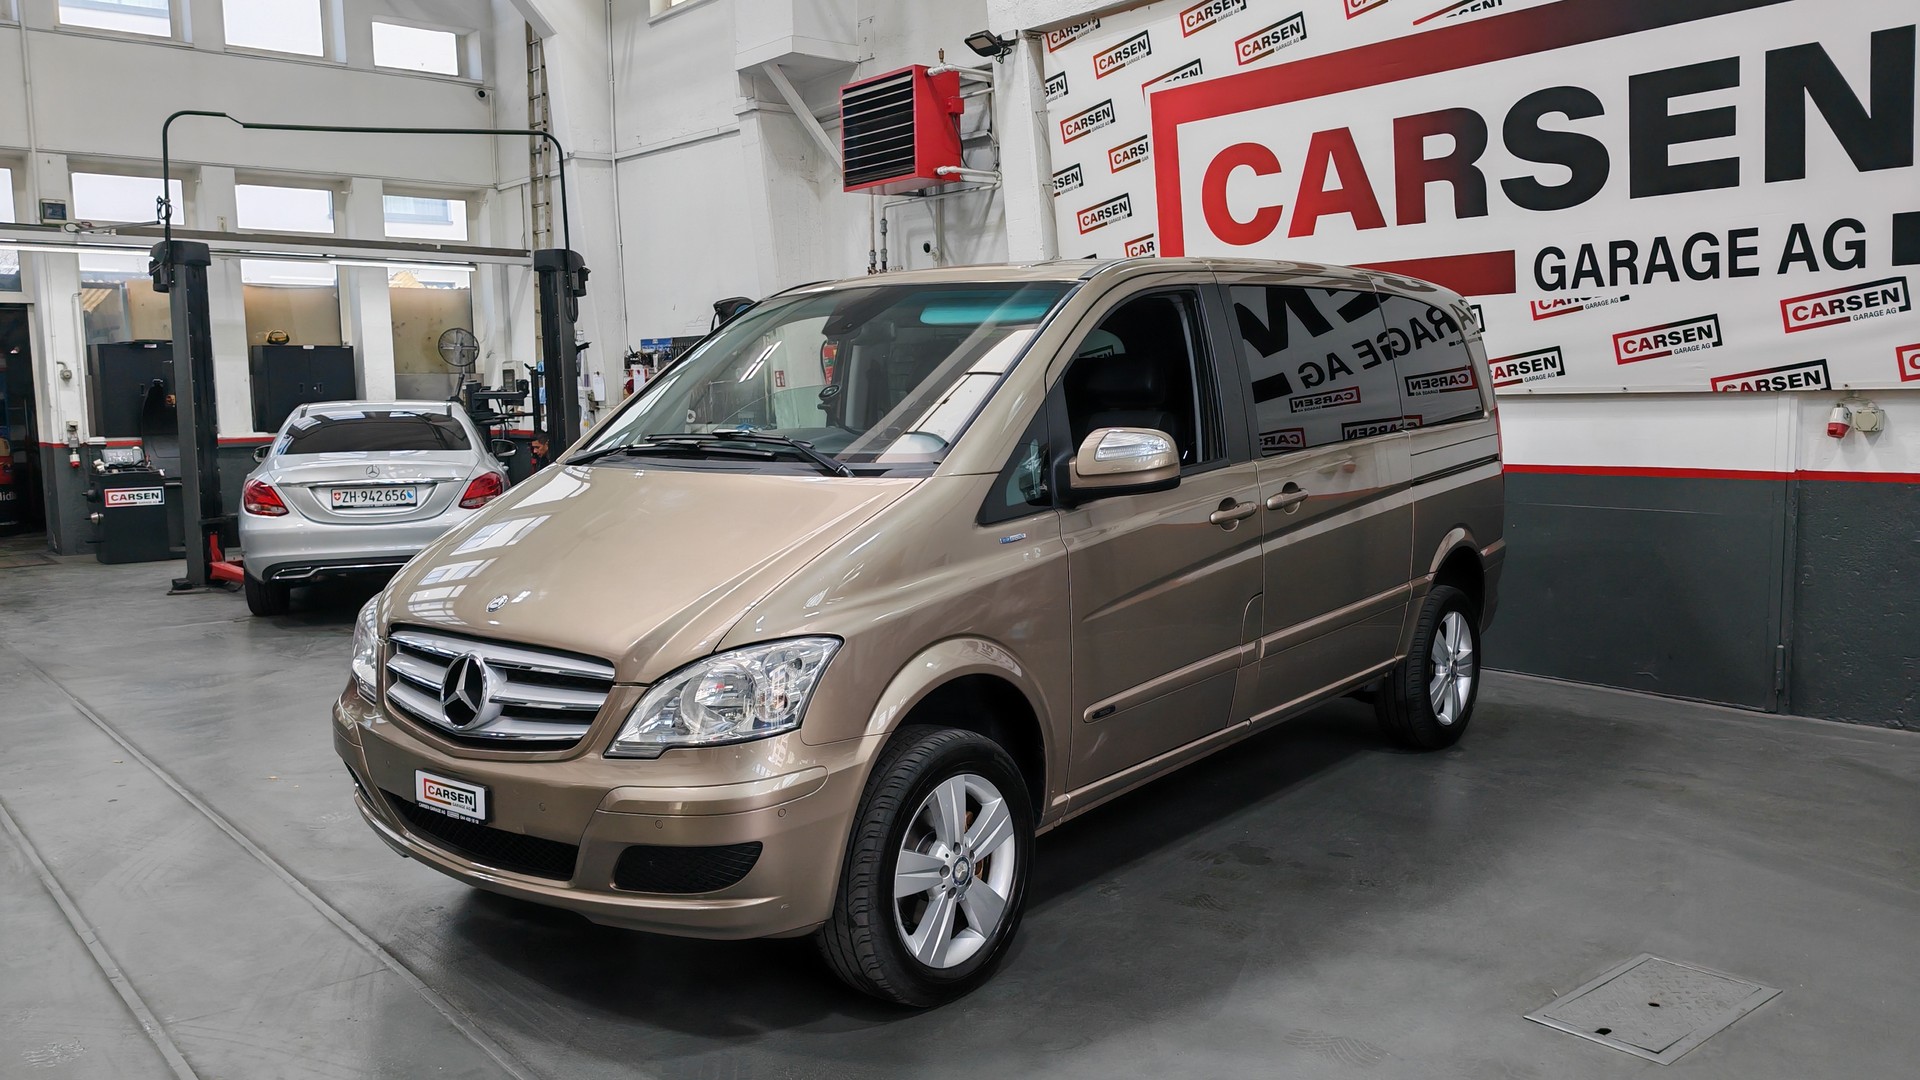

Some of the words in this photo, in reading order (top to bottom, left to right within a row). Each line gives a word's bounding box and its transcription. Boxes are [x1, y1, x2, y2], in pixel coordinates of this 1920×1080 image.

[1241, 21, 1301, 57] CARSEN
[1099, 39, 1147, 70] CARSEN
[1065, 107, 1110, 135] CARSEN
[1201, 24, 1916, 246] CARSEN
[1082, 200, 1128, 226] CARSEN
[1533, 227, 1760, 291] GARAGE
[1777, 218, 1867, 275] AG
[1584, 299, 1609, 310] GARAGE
[1610, 297, 1618, 305] AG
[1792, 287, 1900, 322] CARSEN
[1852, 310, 1884, 321] GARAGE
[1885, 307, 1897, 316] AG
[1622, 324, 1713, 355] CARSEN
[1673, 344, 1700, 355] GARAGE
[1701, 342, 1711, 350] AG
[1524, 373, 1547, 383] GARAGE
[1547, 371, 1555, 379] AG
[111, 492, 159, 502] CARSEN
[427, 785, 473, 806] CARSEN
